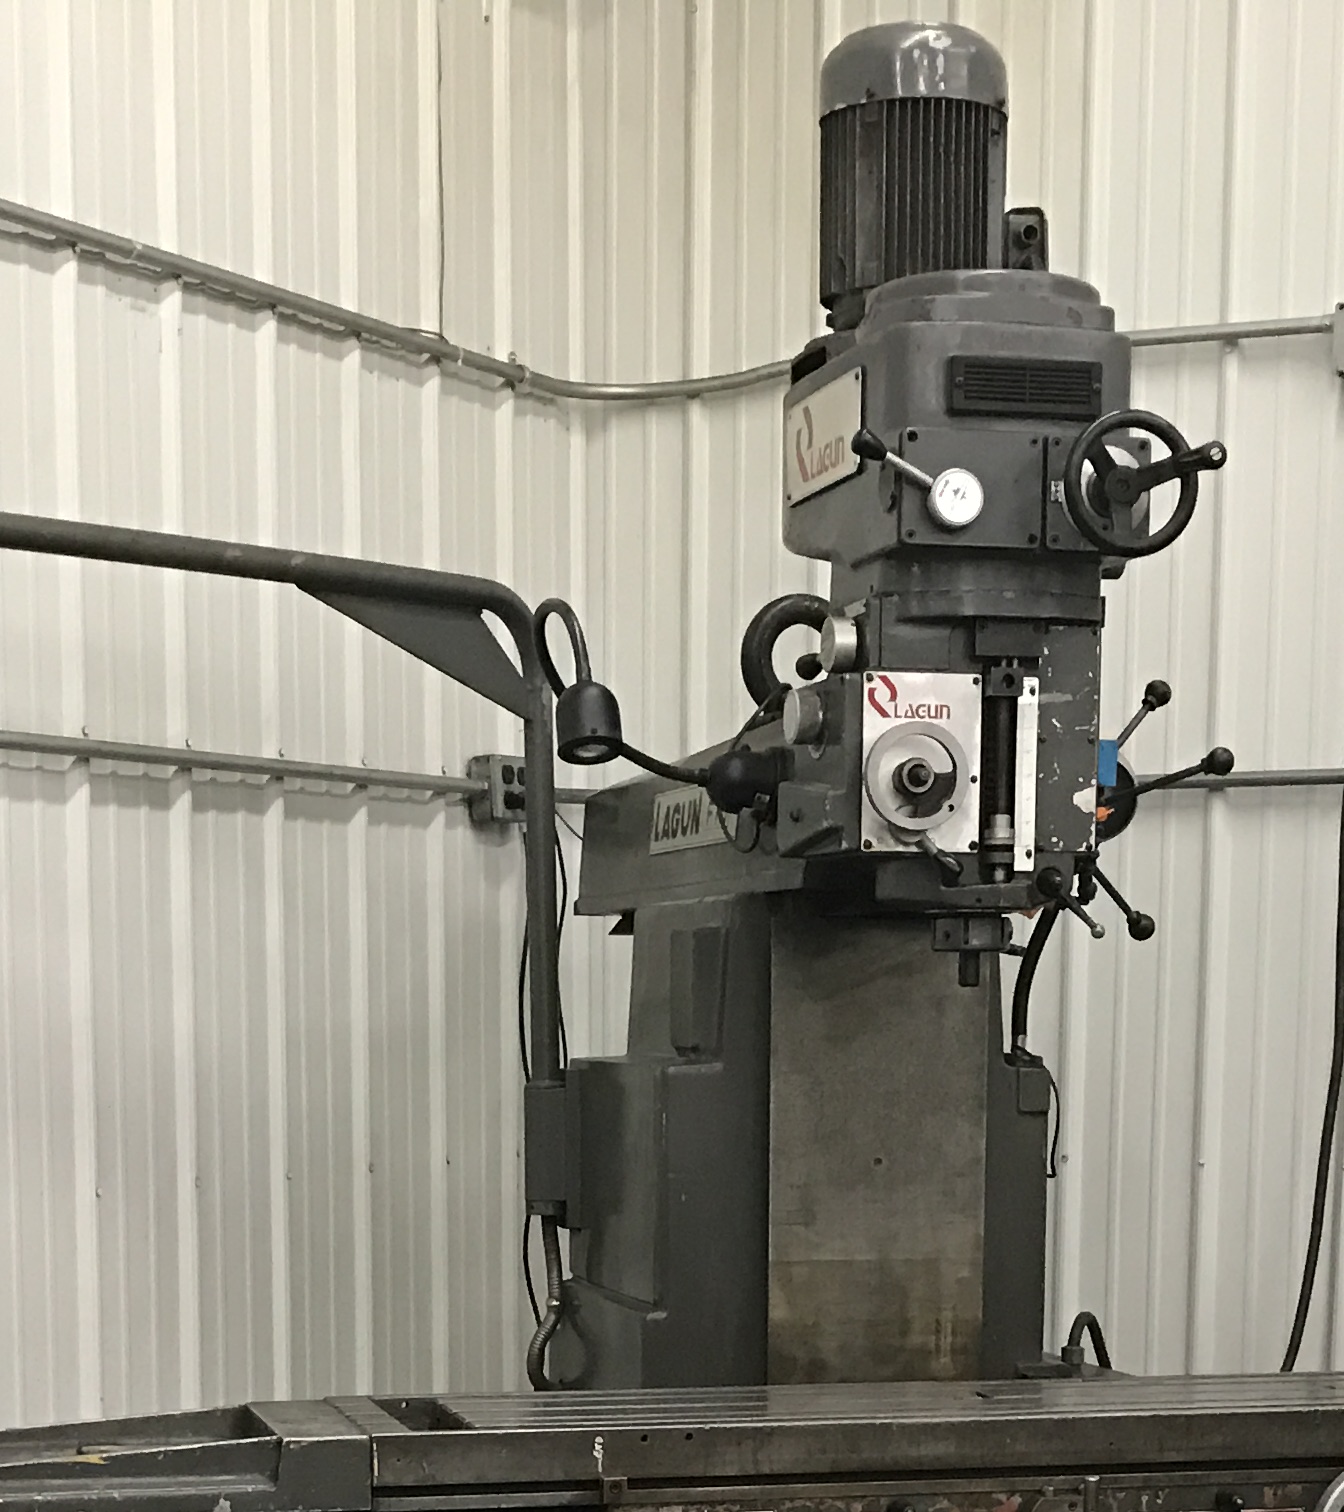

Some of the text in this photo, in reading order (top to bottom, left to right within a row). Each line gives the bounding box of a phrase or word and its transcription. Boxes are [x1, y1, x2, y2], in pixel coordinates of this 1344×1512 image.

[809, 435, 845, 479] LAGUN
[893, 701, 951, 720] LAGUN
[654, 790, 703, 842] LAGUN
